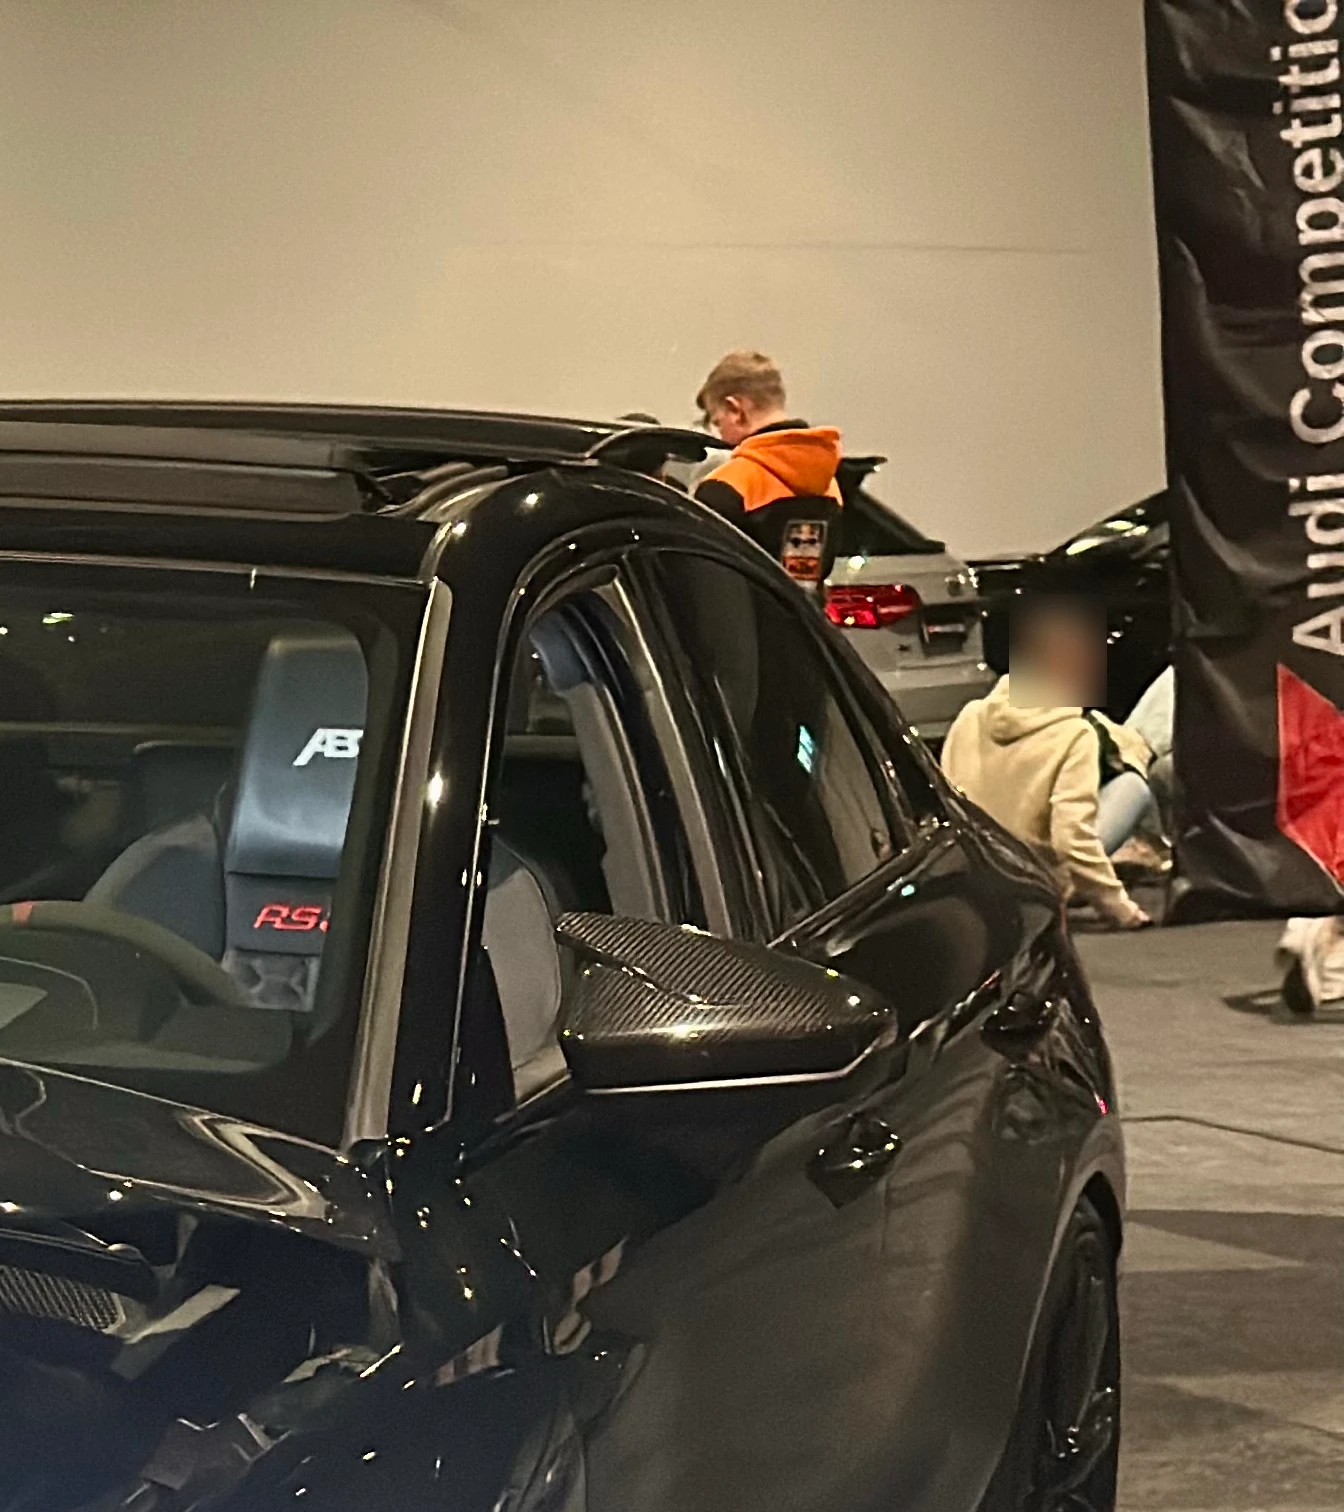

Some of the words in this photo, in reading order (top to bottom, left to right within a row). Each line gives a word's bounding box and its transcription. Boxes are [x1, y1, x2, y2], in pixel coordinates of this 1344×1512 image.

[1288, 472, 1344, 657] Audi
[292, 727, 364, 767] AB
[253, 903, 329, 933] RS
